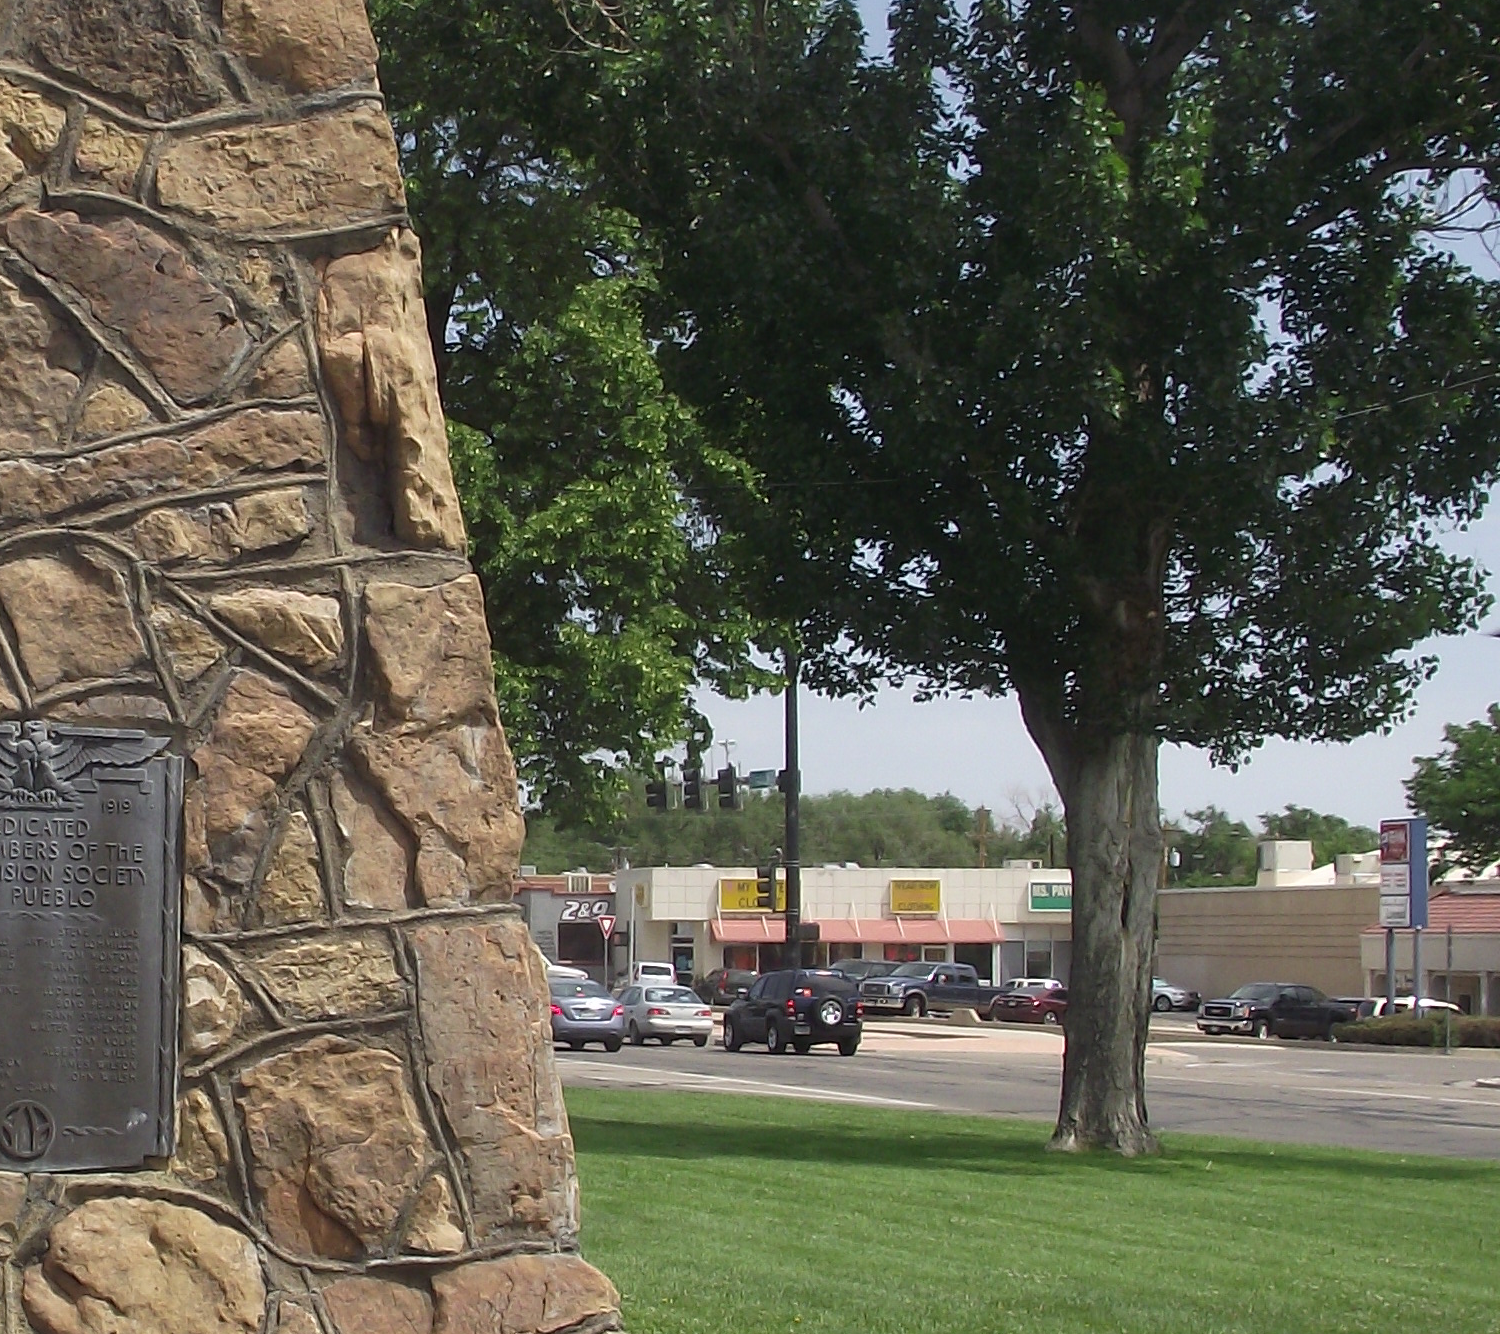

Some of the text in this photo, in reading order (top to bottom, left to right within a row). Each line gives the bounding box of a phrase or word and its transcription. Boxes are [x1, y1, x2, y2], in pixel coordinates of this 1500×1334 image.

[101, 798, 132, 814] 1919
[68, 841, 98, 861] OF
[105, 842, 144, 863] THE
[62, 865, 147, 885] SOCIETY
[11, 886, 97, 908] PUEBLO
